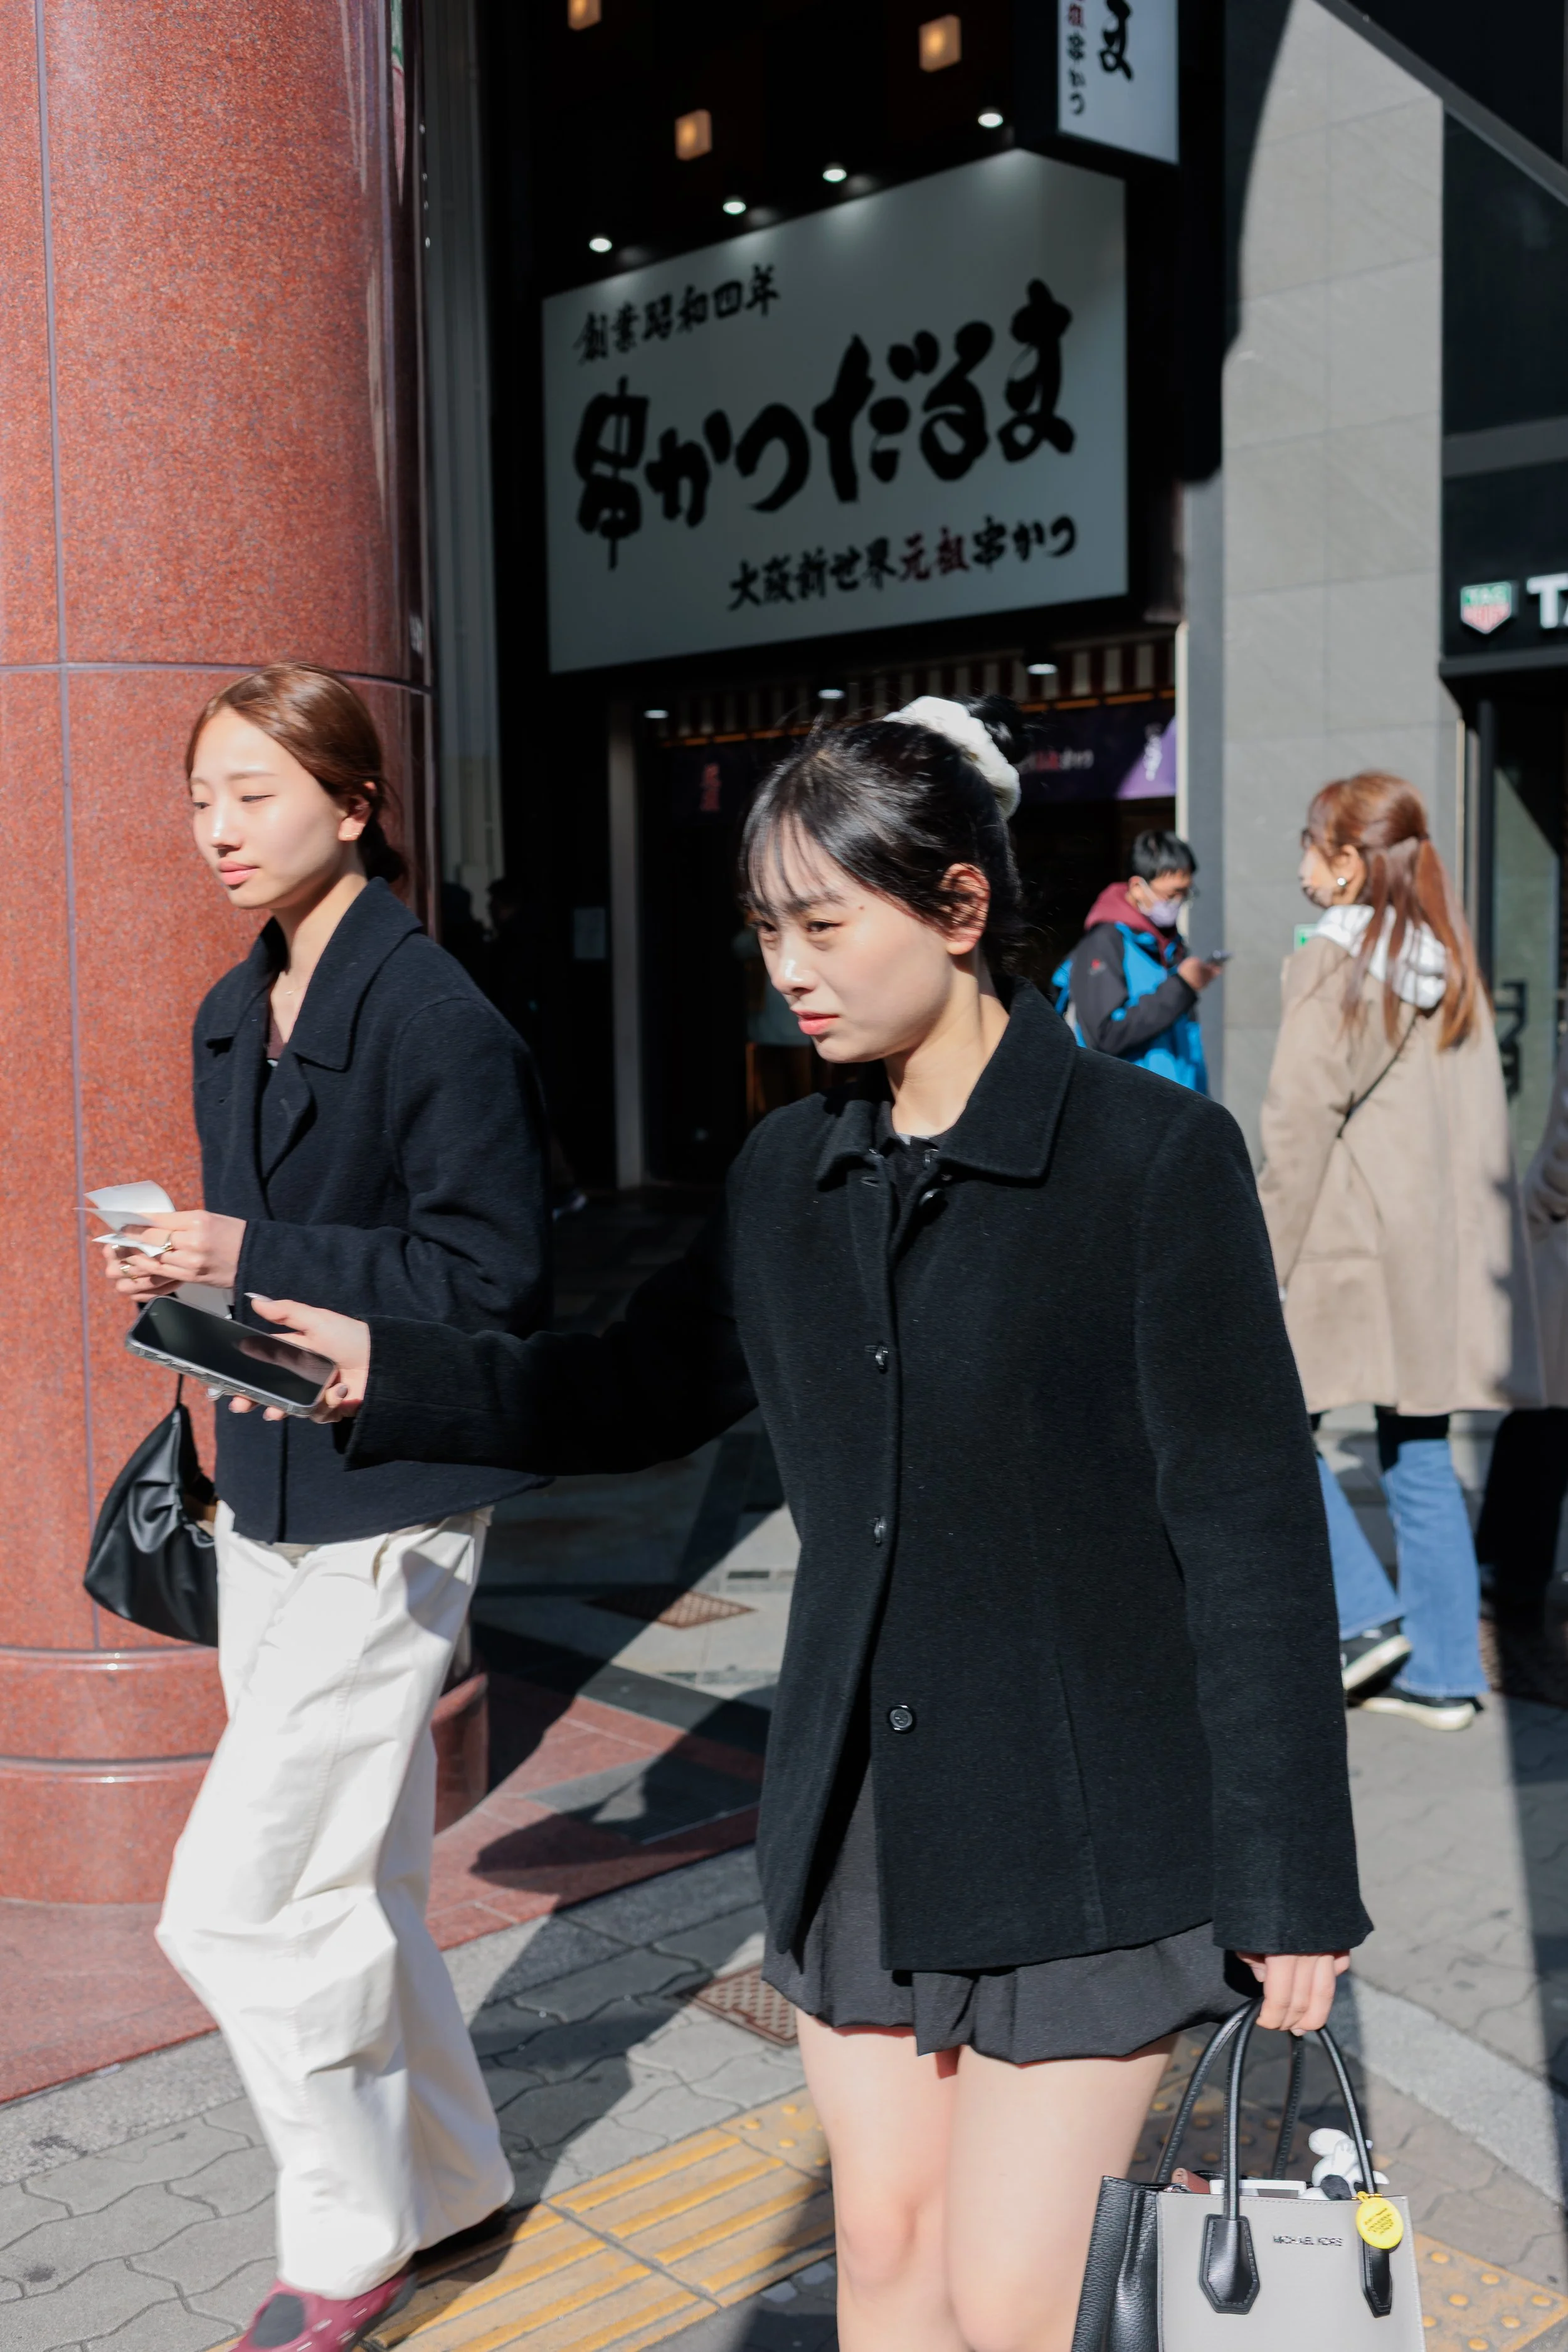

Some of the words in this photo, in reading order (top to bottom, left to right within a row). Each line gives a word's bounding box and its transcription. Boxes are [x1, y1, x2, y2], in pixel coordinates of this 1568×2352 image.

[1067, 0, 1086, 116] 祖串かつ
[573, 264, 780, 365] 創業昭和四年
[573, 279, 1075, 571] 串かつだるま
[728, 514, 1078, 612] 大阪新世界元祖串かつ
